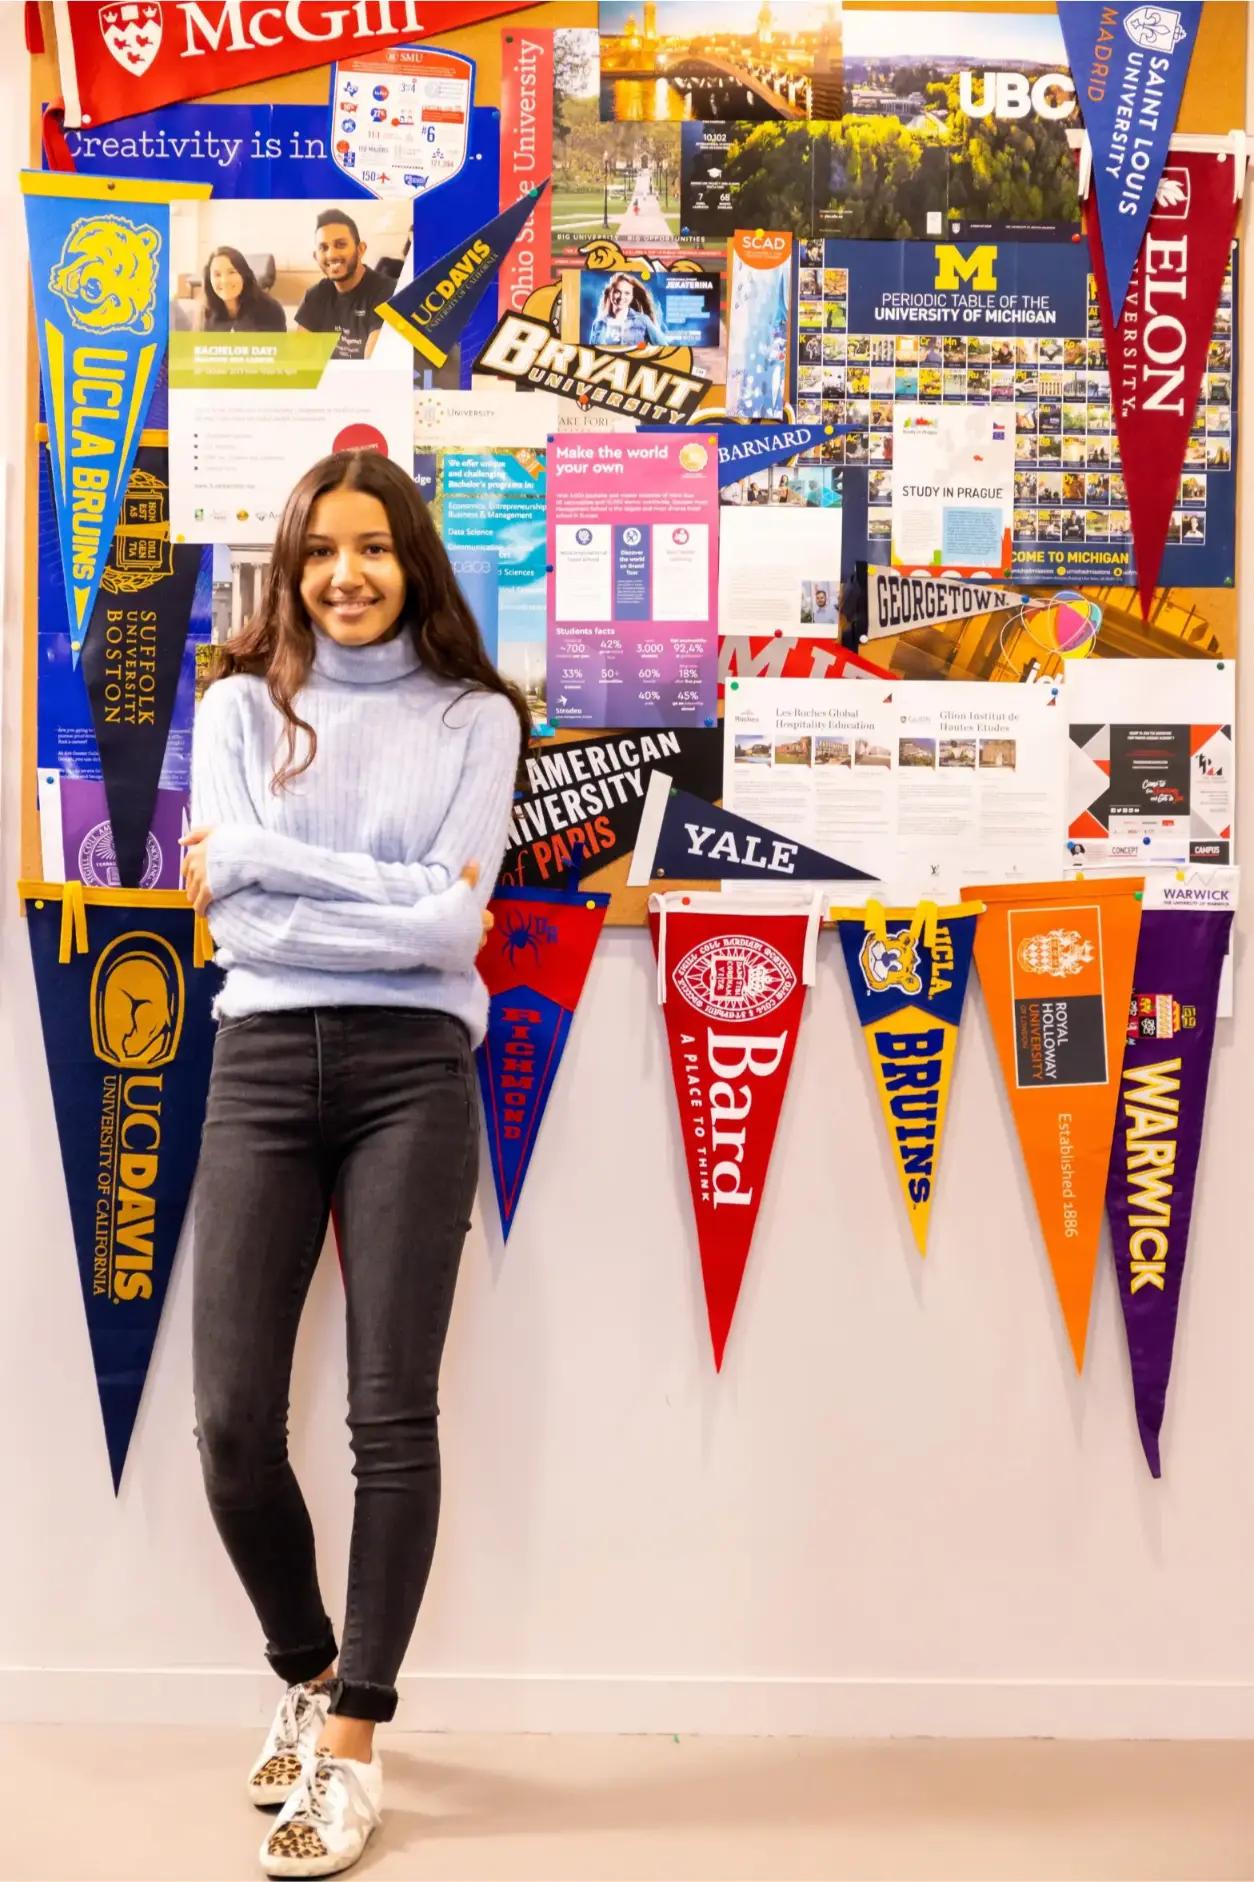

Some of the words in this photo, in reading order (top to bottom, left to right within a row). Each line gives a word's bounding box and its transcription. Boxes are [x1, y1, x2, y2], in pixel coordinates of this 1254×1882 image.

[180, 0, 425, 57] McGill
[400, 52, 424, 63] SMU
[1087, 6, 1119, 102] MADRID
[513, 39, 544, 173] University
[959, 71, 1076, 120] UBC
[1138, 55, 1169, 132] SAINT
[1105, 52, 1144, 179] UNIVERSITY
[64, 130, 243, 167] Creativity
[250, 130, 293, 159] is
[293, 131, 329, 159] in
[362, 170, 376, 182] 150
[1118, 136, 1153, 216] LOUIS
[720, 193, 731, 201] 68
[557, 233, 571, 241] BIG
[573, 233, 619, 242] UNIVERSITY
[643, 235, 706, 243] OPPORTUNITIES
[742, 236, 786, 250] SCAD
[934, 244, 998, 291] M
[425, 296, 458, 333] UNIVERSITY
[466, 251, 500, 290] CALIFORNIA
[882, 293, 947, 308] PERIODIC
[951, 293, 995, 309] TABLE
[999, 295, 1018, 309] OF
[1022, 295, 1050, 309] THE
[874, 307, 960, 322] UNIVERSITY
[963, 308, 983, 322] OF
[987, 308, 1056, 323] MICHIGAN
[1143, 232, 1188, 417] ELON
[194, 346, 249, 356] BACHELOR
[943, 337, 957, 346] Mn
[479, 315, 703, 410] BRYANT
[72, 347, 128, 457] UCLA
[528, 367, 686, 425] UNIVERSITY
[556, 446, 594, 459] Make
[597, 446, 623, 459] the
[626, 445, 669, 459] world
[719, 428, 812, 464] BARNARD
[448, 460, 460, 468] We
[461, 460, 478, 468] offer
[480, 460, 506, 470] unique
[448, 470, 462, 478] and
[463, 470, 506, 480] challenging
[556, 463, 588, 476] your
[592, 463, 624, 473] own
[448, 480, 486, 488] Bachelor's
[488, 481, 524, 490] programs
[526, 480, 534, 489] in:
[902, 486, 940, 498] STUDY
[942, 486, 954, 498] IN
[957, 487, 1004, 499] PRAGUE
[72, 466, 110, 580] BRUINS
[139, 502, 148, 521] EST
[147, 501, 157, 522] HON
[488, 511, 533, 520] Management
[448, 528, 465, 536] Data
[466, 528, 494, 536] Science
[139, 540, 147, 560] GEN
[1048, 551, 1065, 563] TO
[1067, 551, 1130, 565] MICHIGAN
[504, 568, 534, 576] Sciences
[556, 627, 593, 635] Students
[593, 627, 616, 635] facts
[600, 640, 622, 649] 42%
[673, 643, 704, 654] 92,4%
[104, 609, 123, 724] BOSTON
[124, 610, 138, 725] UNIVERSITY
[138, 610, 157, 725] SUFFOLK
[562, 668, 583, 678] 33%
[601, 668, 620, 678] 50+
[638, 668, 661, 678] 60%
[679, 668, 699, 678] 18%
[638, 691, 661, 700] 40%
[677, 691, 699, 700] 45%
[775, 708, 791, 718] Les
[794, 708, 827, 718] Roches
[828, 708, 859, 719] Global
[775, 720, 826, 731] Hospitality
[827, 720, 875, 731] Education
[939, 711, 966, 721] Glion
[968, 711, 1006, 721] Institut
[1009, 711, 1020, 721] de
[939, 723, 974, 732] Hautes
[976, 723, 1011, 733] Etudes
[525, 730, 682, 795] AMERICAN
[506, 768, 645, 850] NIVERSITY
[531, 815, 617, 880] PARIS
[684, 822, 799, 874] YALE
[1111, 846, 1139, 855] CONCEPT
[1194, 845, 1220, 854] CAMPUS
[1163, 888, 1230, 901] WARWICK
[1020, 1004, 1028, 1014] OF
[1021, 1015, 1029, 1049] LONDON
[1055, 1002, 1069, 1046] ROYAL
[680, 1033, 695, 1044] A
[1029, 1003, 1044, 1080] UNIVERSITY
[1042, 1003, 1057, 1079] HOLLOWAY
[500, 1007, 543, 1140] RICHMOND
[683, 1052, 702, 1107] PLACE
[98, 1075, 116, 1170] UNIVERSITY
[693, 1116, 706, 1138] TO
[707, 1026, 788, 1210] Bard
[875, 1028, 945, 1204] BRUINS
[1058, 1113, 1077, 1198] Established
[97, 1172, 111, 1195] OF
[697, 1147, 710, 1202] THINK
[1122, 1057, 1182, 1295] WARWICK
[1063, 1200, 1079, 1239] 1886
[92, 1199, 111, 1297] CALIFORNIA
